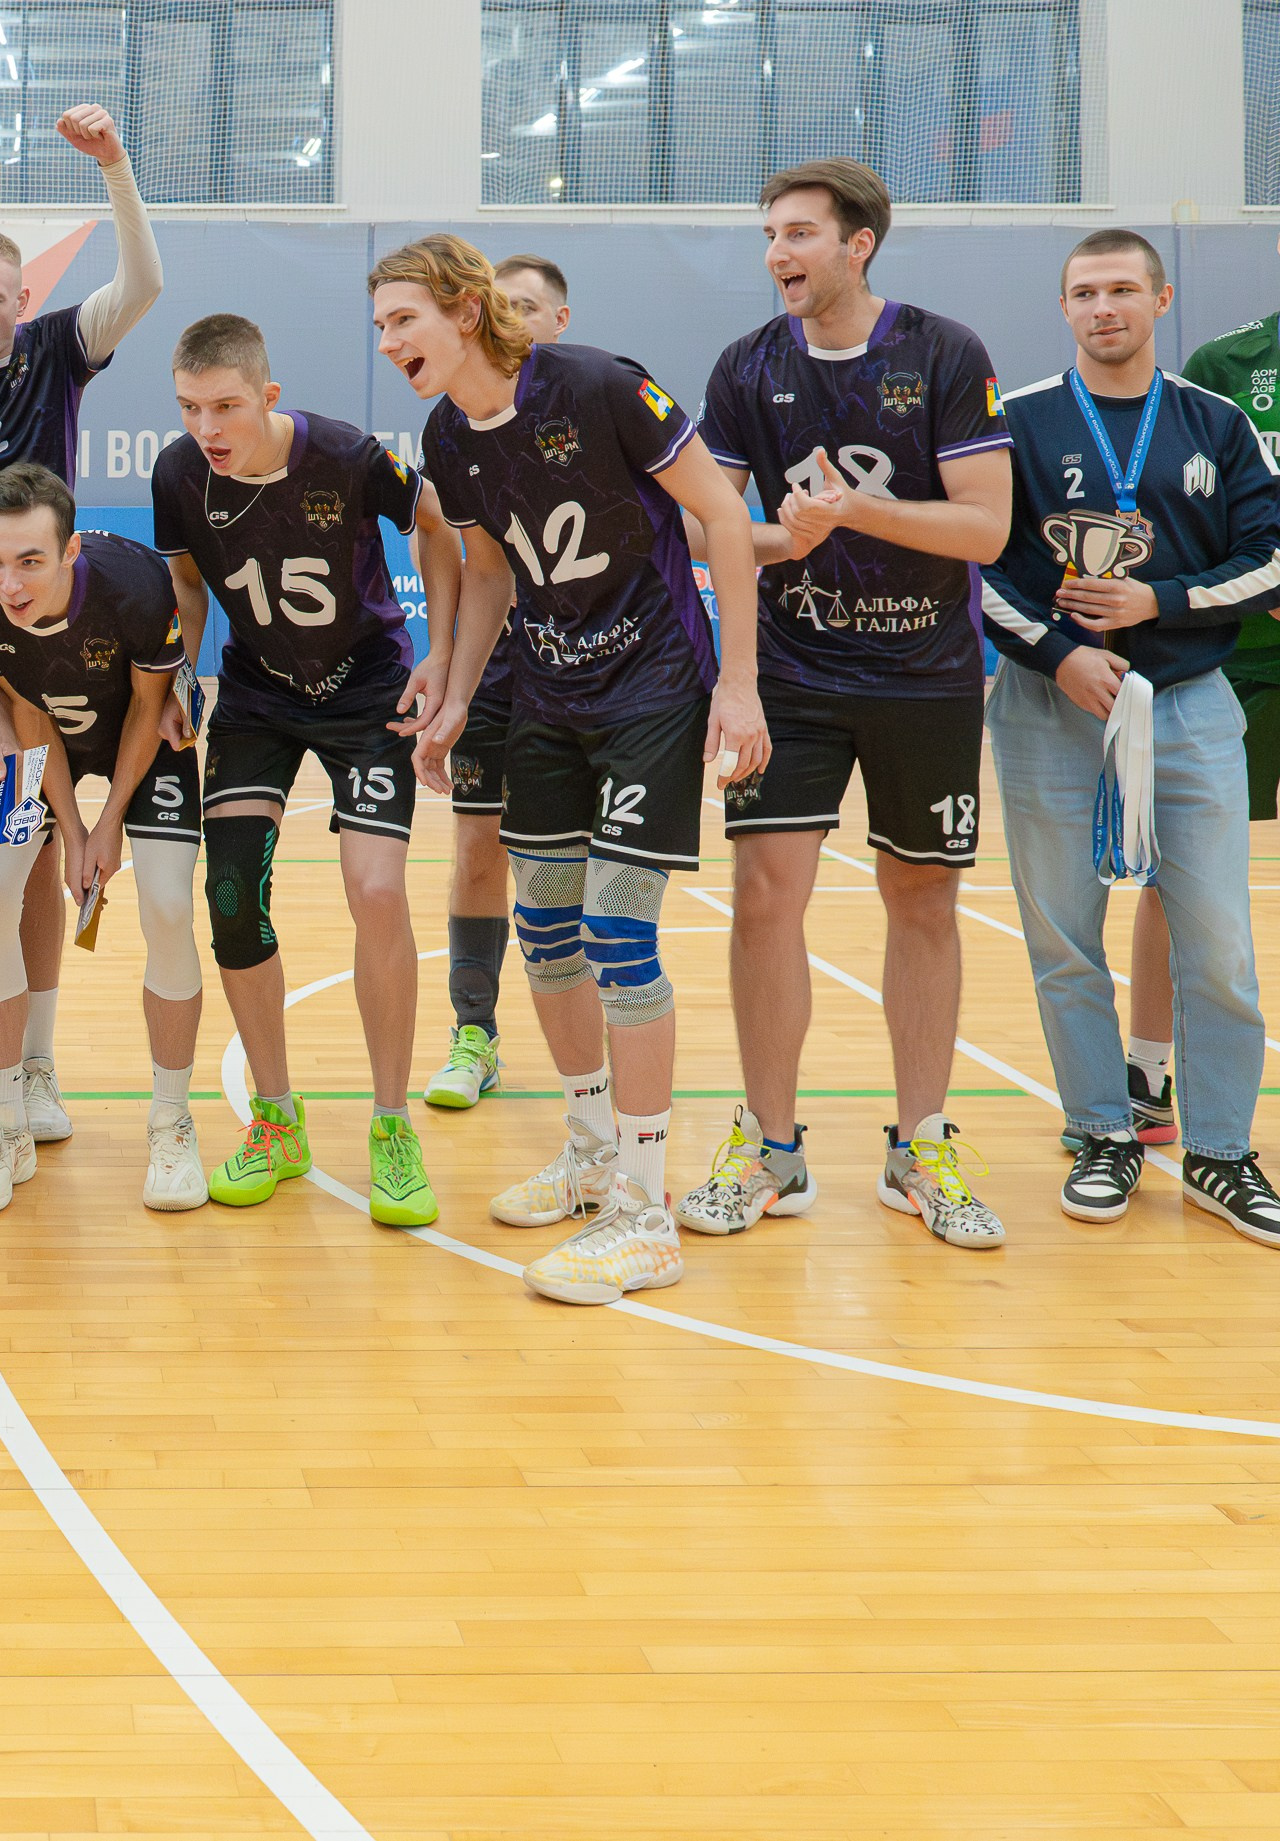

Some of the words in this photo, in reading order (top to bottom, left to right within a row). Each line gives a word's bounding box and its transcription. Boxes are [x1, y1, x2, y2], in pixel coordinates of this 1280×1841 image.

[772, 393, 795, 403] GS
[106, 429, 186, 479] ВО
[1061, 453, 1082, 465] GS
[1063, 467, 1085, 500] 2
[209, 511, 229, 521] GS
[504, 500, 610, 587] 12
[224, 556, 337, 627] 15
[853, 595, 940, 614] АЛЬФА-
[854, 610, 939, 633] ГАЛАНТ
[42, 693, 98, 735] 5
[151, 775, 184, 808] 5
[348, 766, 396, 801] 15
[355, 803, 377, 814] GS
[600, 777, 645, 825] 12
[929, 794, 977, 835] 18
[157, 811, 180, 821] GS
[601, 823, 623, 837] GS
[946, 839, 970, 849] GS
